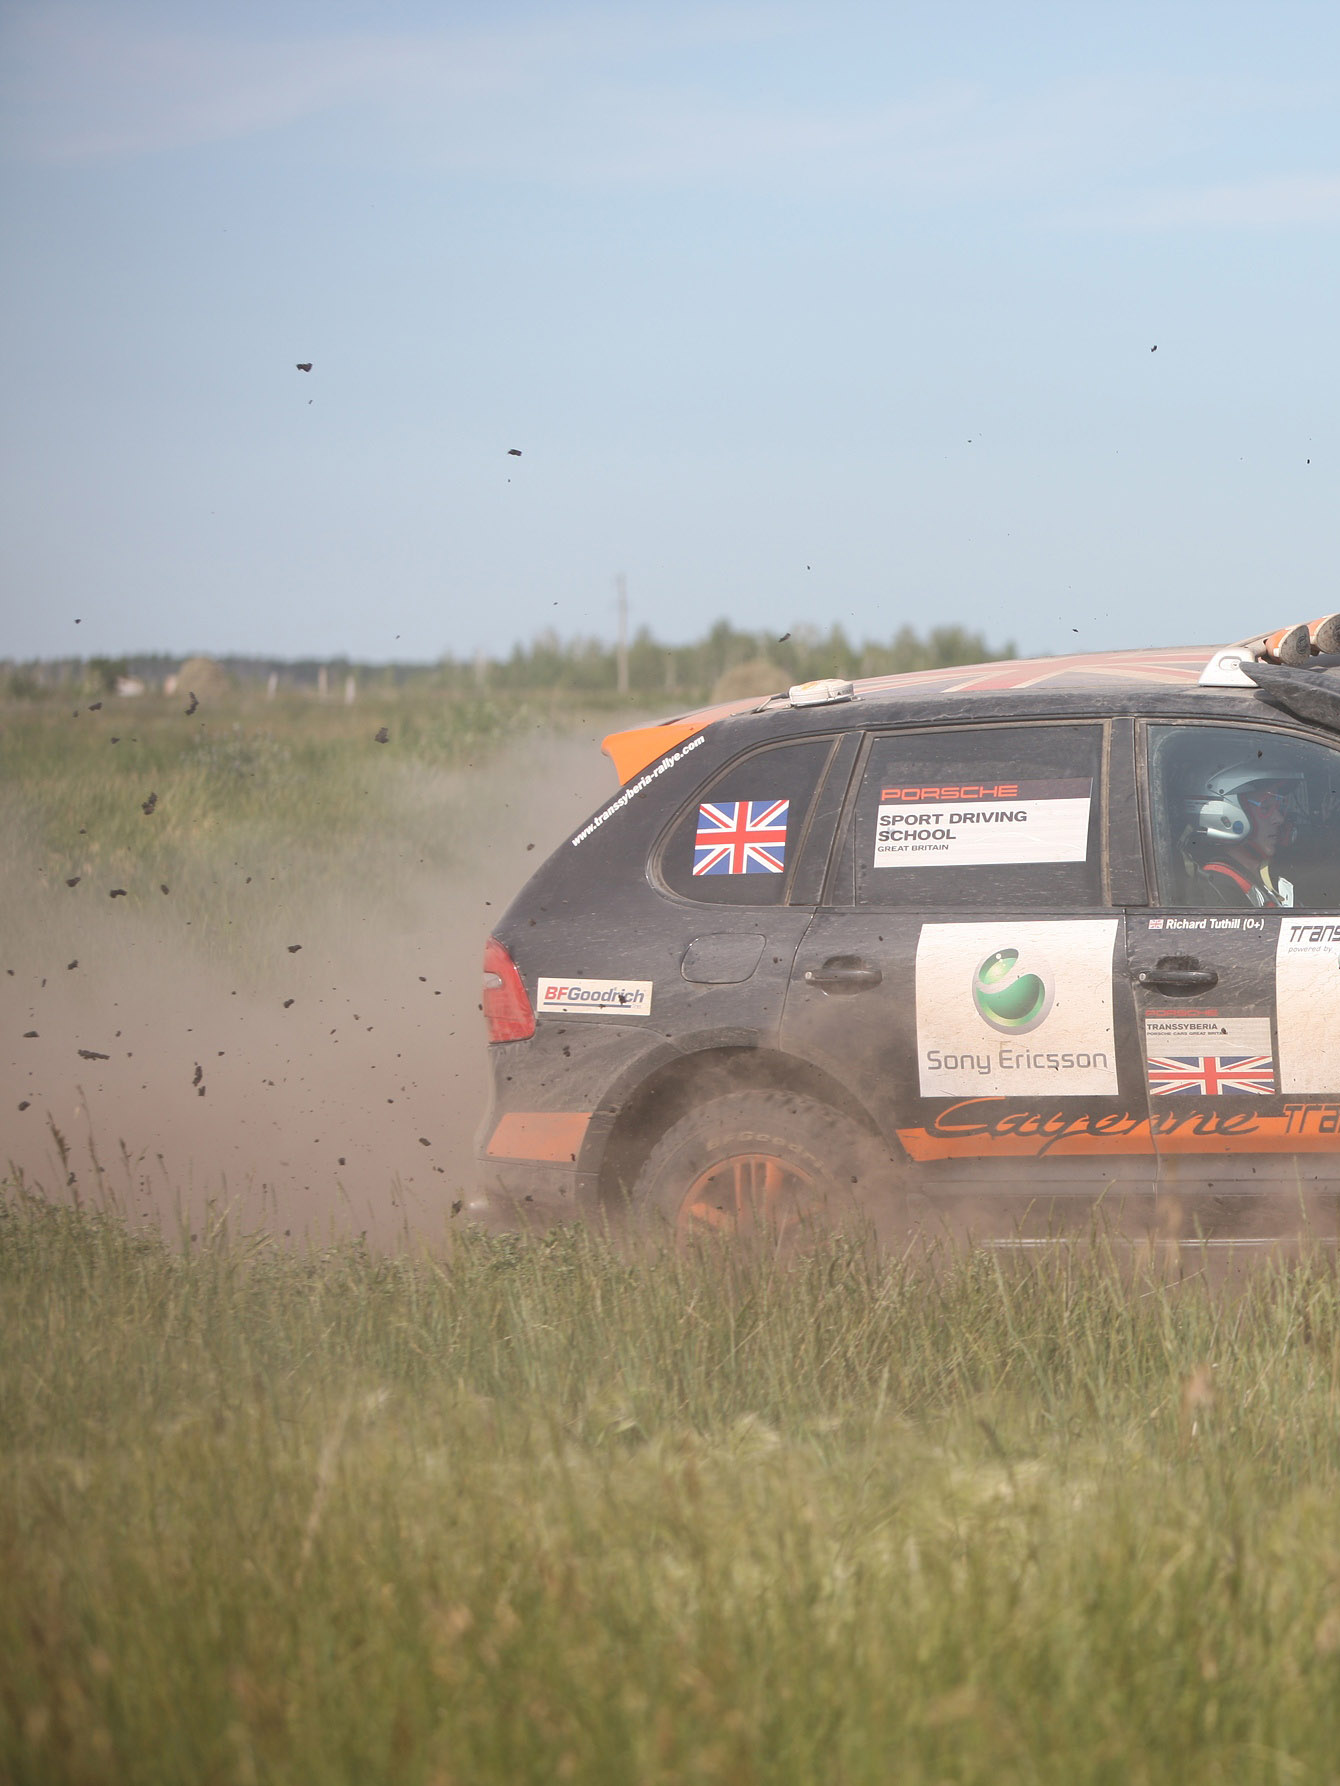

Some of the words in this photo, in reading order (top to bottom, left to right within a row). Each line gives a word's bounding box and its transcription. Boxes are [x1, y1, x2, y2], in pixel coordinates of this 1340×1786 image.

[571, 735, 705, 847] www.transsyberia-rallye.com
[881, 784, 1019, 801] PORSCHE
[879, 813, 944, 827] SPORT
[949, 810, 1028, 824] DRIVING
[878, 828, 957, 842] SCHOOL
[877, 845, 910, 853] GREAT
[911, 844, 949, 852] BRITAIN
[1166, 918, 1207, 930] Richard
[1209, 918, 1241, 929] Tuthill
[1288, 946, 1322, 954] powered
[1324, 945, 1333, 954] by
[544, 986, 645, 1003] BFGoodrich
[927, 1050, 992, 1075] Sony
[999, 1049, 1108, 1069] Ericsson
[925, 1095, 1260, 1158] Cayenne
